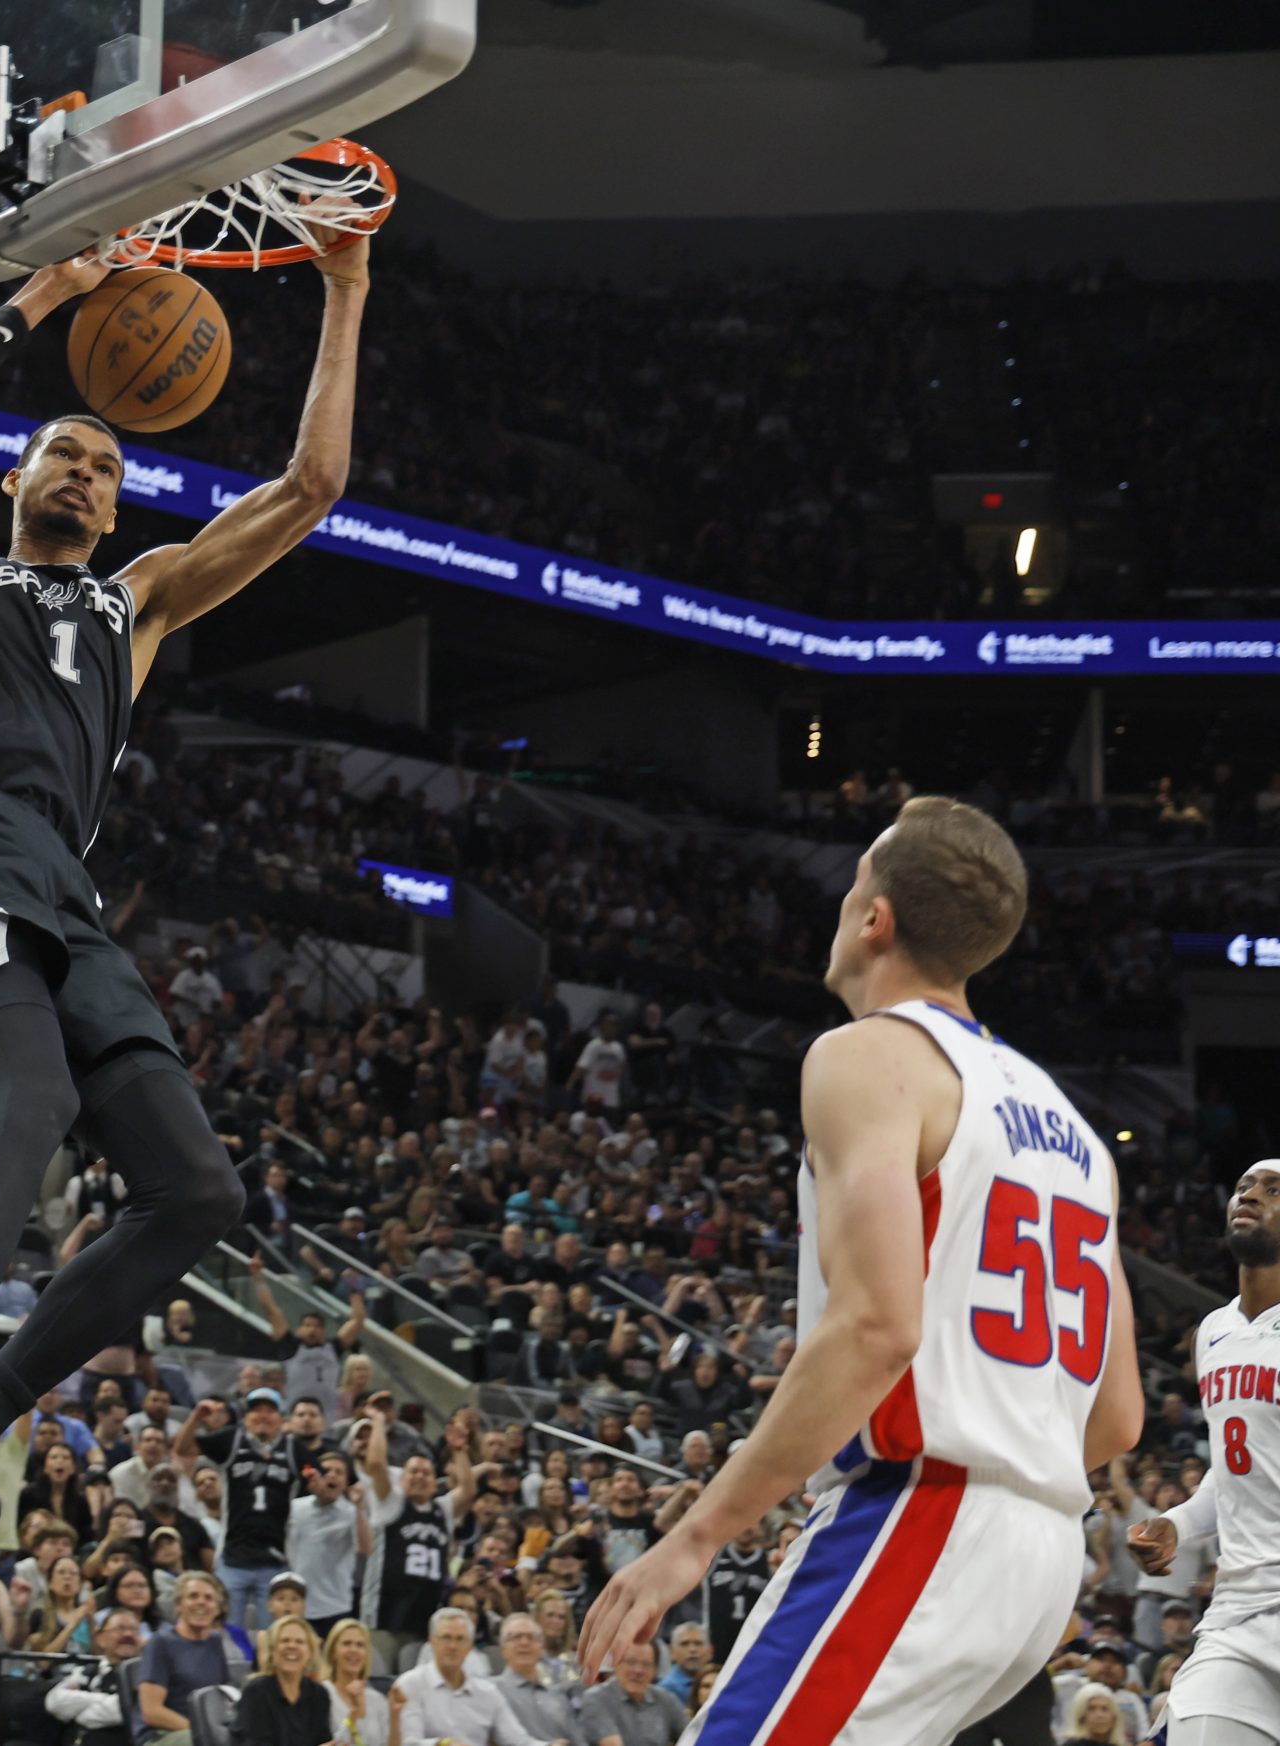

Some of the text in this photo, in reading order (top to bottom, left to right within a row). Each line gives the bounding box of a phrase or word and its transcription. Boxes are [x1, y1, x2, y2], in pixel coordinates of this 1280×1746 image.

[50, 619, 81, 685] 1
[1148, 636, 1212, 659] Learn
[970, 1175, 1110, 1387] 55
[1224, 1416, 1252, 1475] 8
[253, 1485, 267, 1511] 1
[405, 1543, 441, 1580] 21
[733, 1595, 746, 1619] 1
